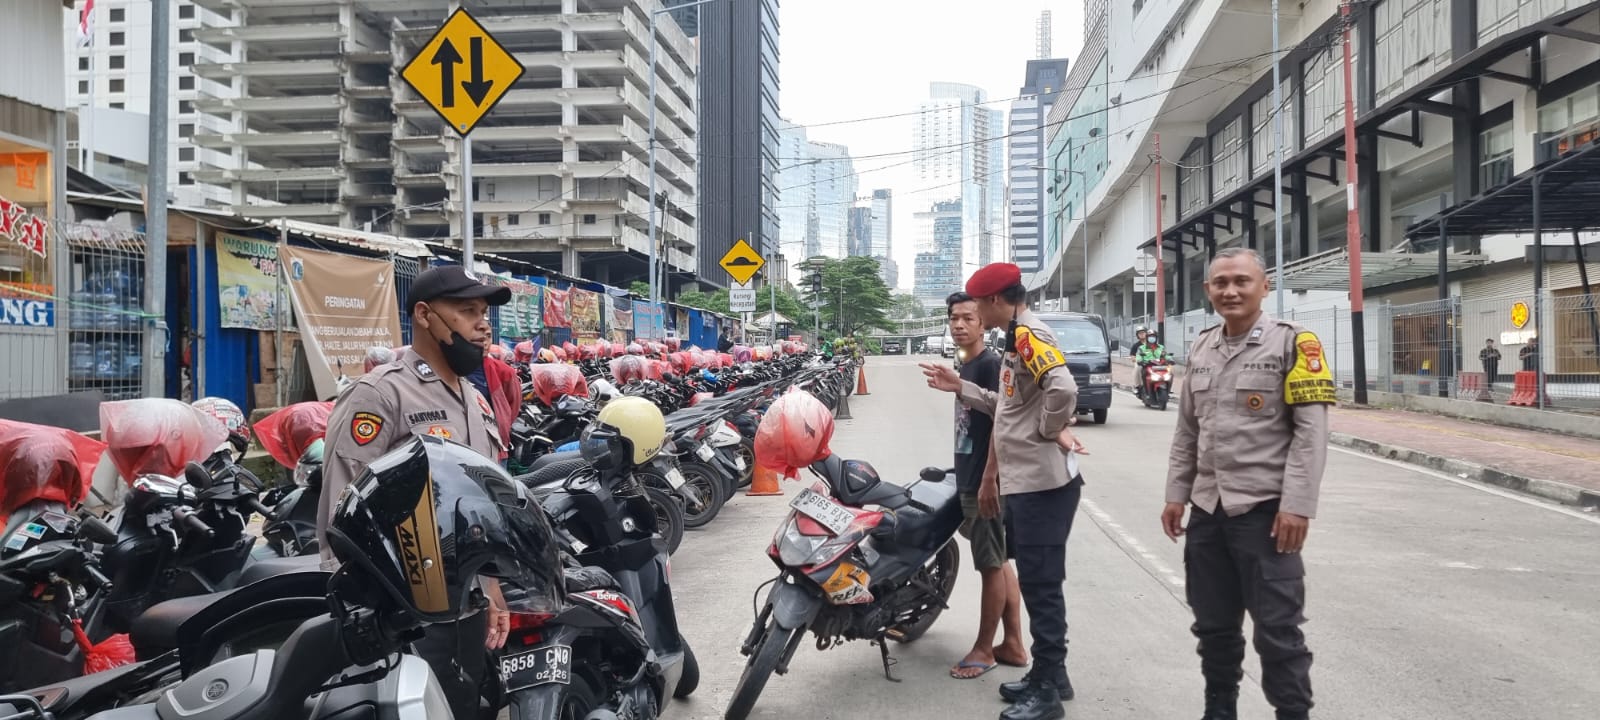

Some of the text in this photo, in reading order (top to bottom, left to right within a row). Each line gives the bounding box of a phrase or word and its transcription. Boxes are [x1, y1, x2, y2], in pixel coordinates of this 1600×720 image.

[223, 237, 277, 258] WARUNG
[324, 295, 366, 309] PERINGATAN
[1244, 362, 1277, 371] POLRI
[800, 487, 852, 524] B 6165 BXK
[400, 526, 423, 584] MAXI
[502, 654, 535, 674] 6858
